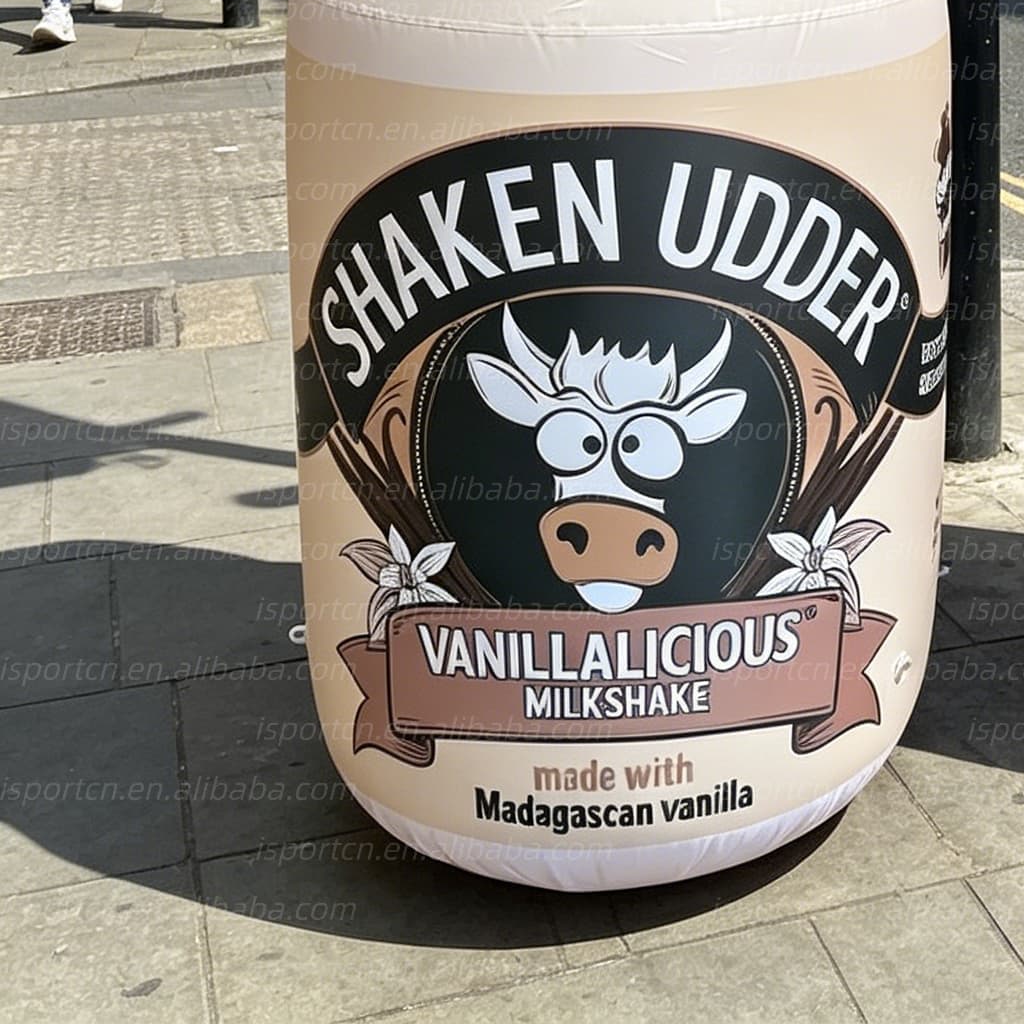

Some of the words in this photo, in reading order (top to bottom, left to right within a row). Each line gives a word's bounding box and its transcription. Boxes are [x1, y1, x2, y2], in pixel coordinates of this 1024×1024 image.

[323, 159, 620, 388] SHAKEN
[524, 679, 711, 719] MILKSHAKE
[533, 760, 615, 792] made
[624, 753, 694, 791] with
[474, 787, 654, 835] Madagascan
[661, 779, 753, 822] vanilla
